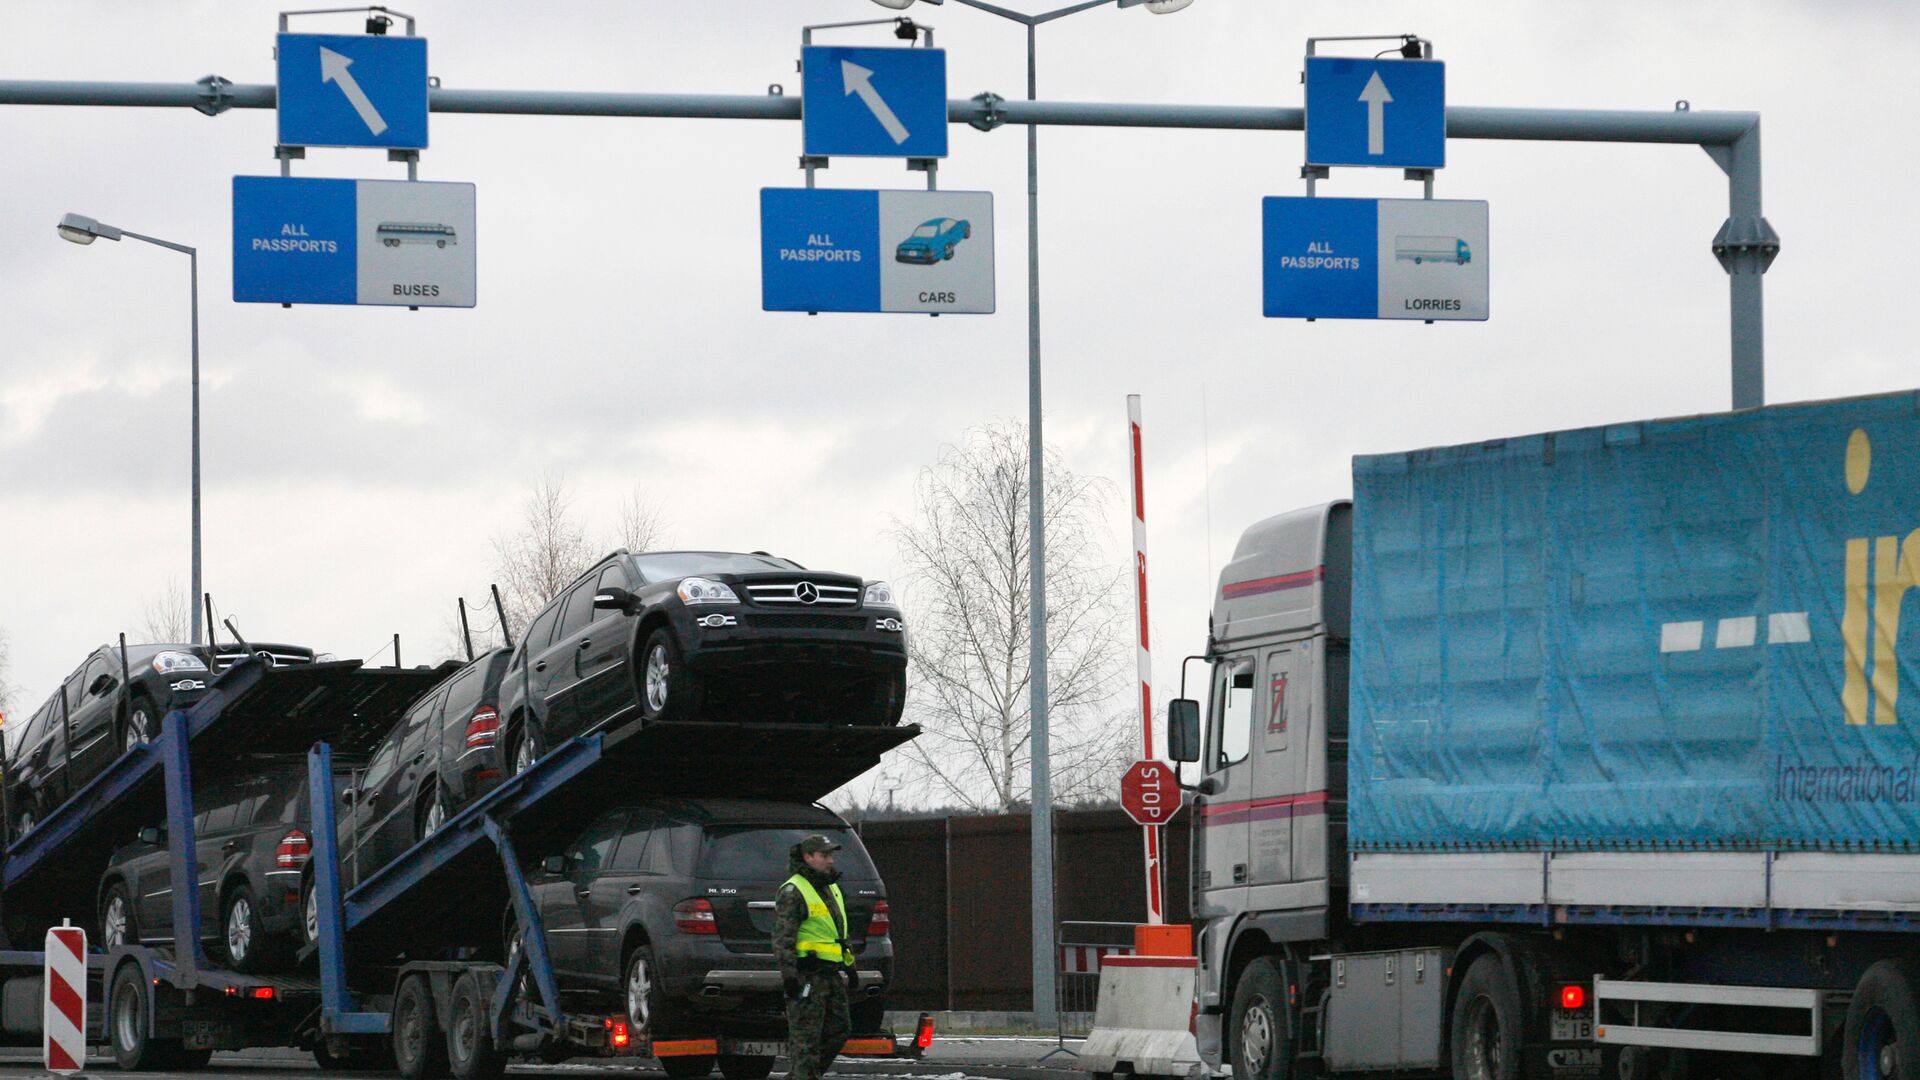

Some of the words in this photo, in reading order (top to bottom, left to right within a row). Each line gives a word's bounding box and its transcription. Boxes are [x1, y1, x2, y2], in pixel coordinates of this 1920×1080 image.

[281, 223, 309, 237] ALL
[252, 238, 338, 253] PASSPORTS
[807, 233, 834, 247] ALL
[1307, 241, 1334, 254] ALL
[780, 248, 861, 262] PASSPORTS
[1281, 256, 1360, 270] PASSPORTS
[393, 283, 439, 297] BUSES
[918, 291, 956, 304] CARS
[1404, 298, 1461, 311] LORRIES
[1774, 753, 1920, 803] International
[1141, 767, 1160, 818] STOP
